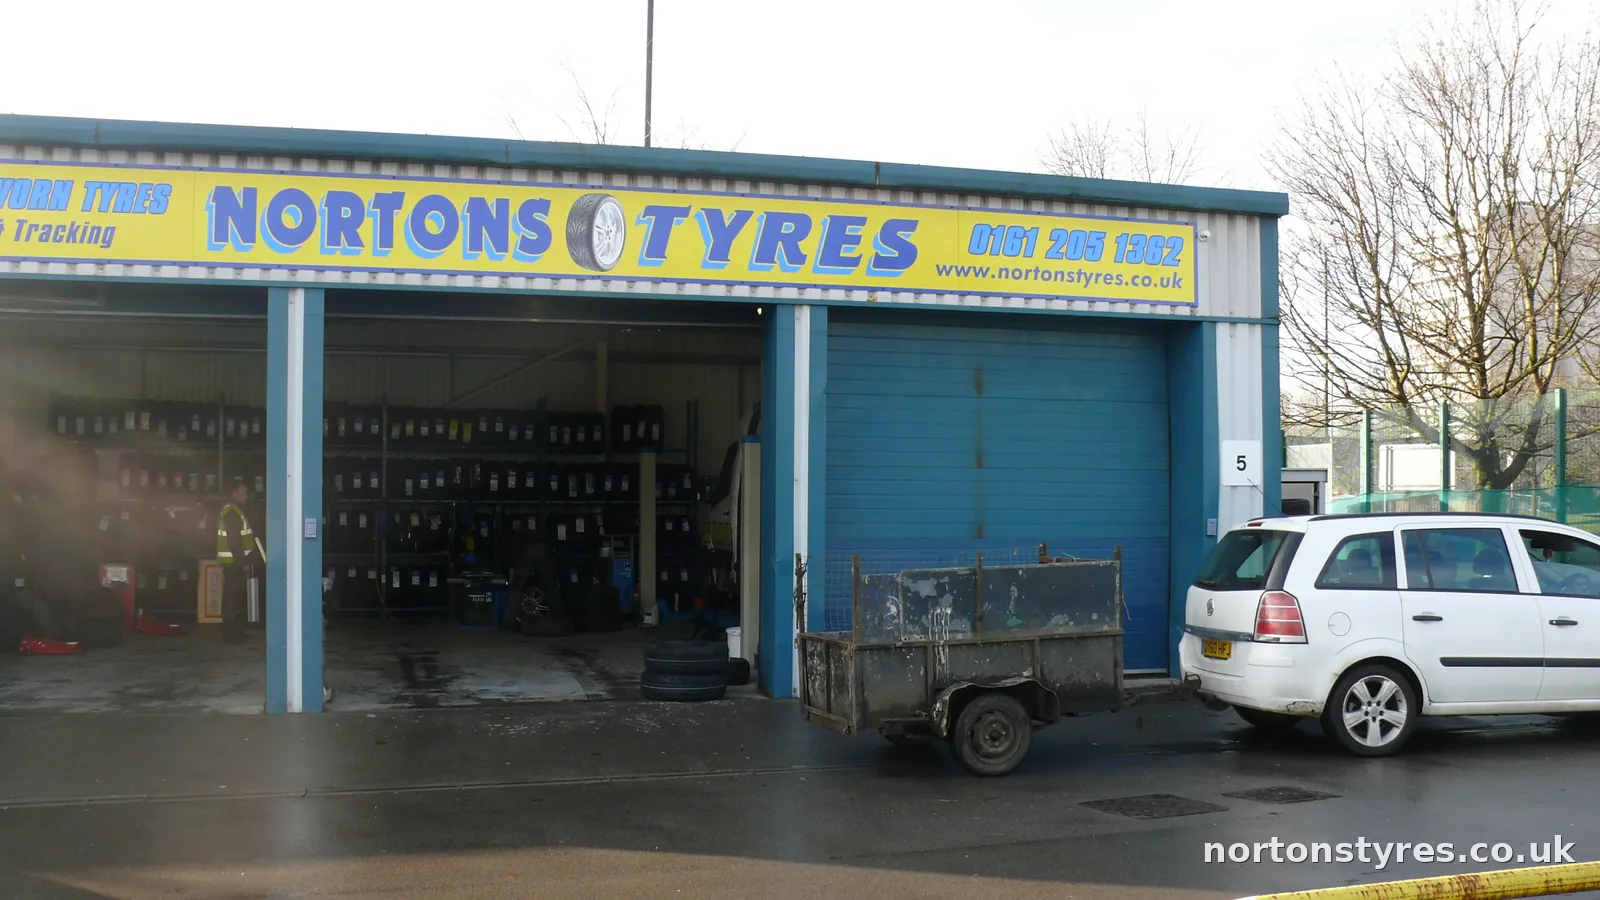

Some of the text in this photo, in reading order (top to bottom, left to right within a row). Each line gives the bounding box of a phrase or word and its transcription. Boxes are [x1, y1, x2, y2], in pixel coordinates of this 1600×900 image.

[81, 181, 172, 214] TYRES
[13, 219, 116, 248] Tracking
[204, 186, 920, 277] NORTONS TYRES
[968, 224, 1184, 267] 0161 205 1362
[936, 264, 1183, 288] www.nortonstyres.co.uk
[1236, 455, 1247, 471] 5
